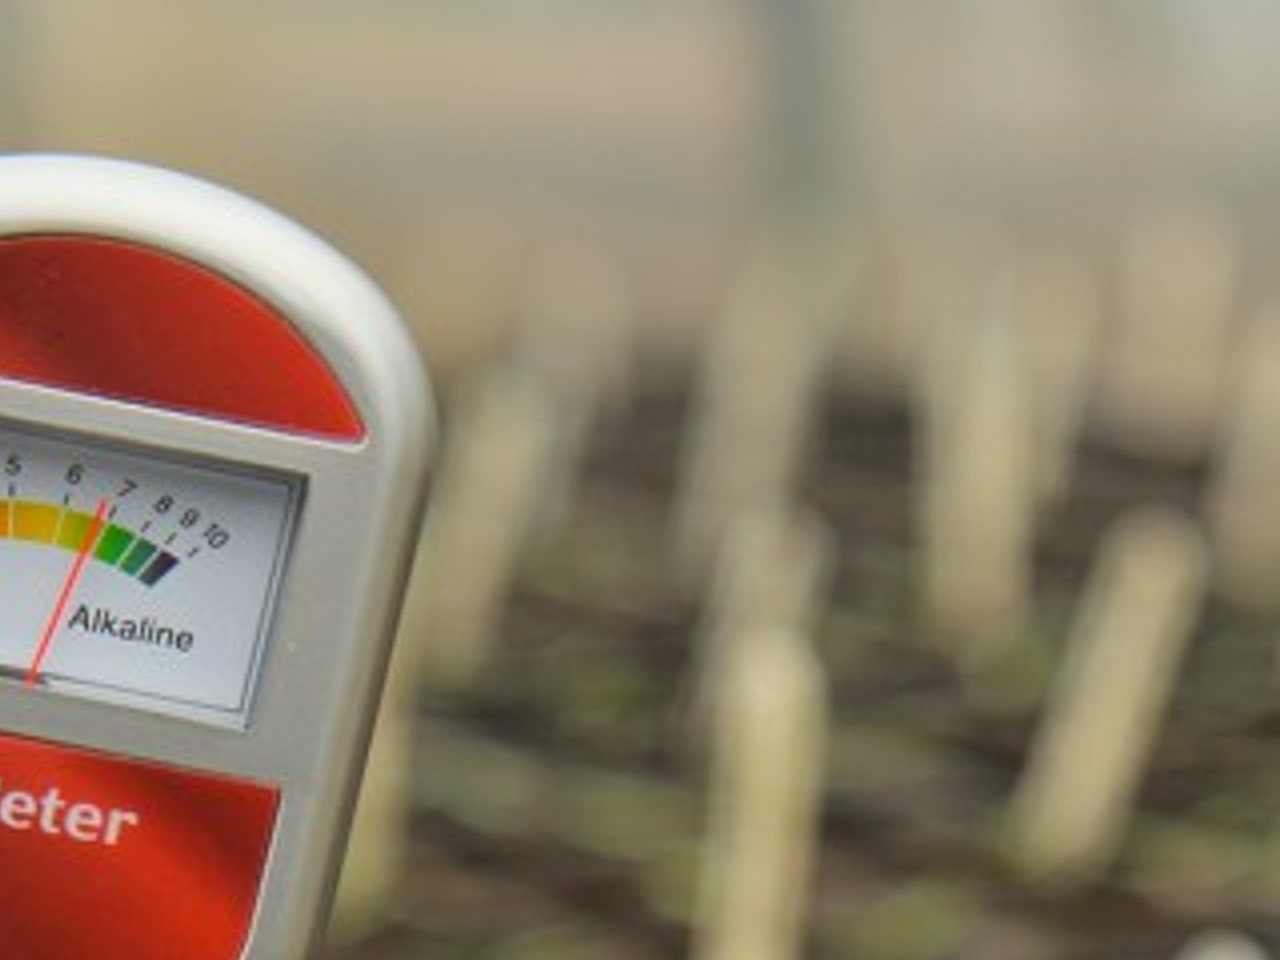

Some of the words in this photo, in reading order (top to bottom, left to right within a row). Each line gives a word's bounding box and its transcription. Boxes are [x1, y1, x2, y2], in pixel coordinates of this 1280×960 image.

[3, 456, 22, 477] 5
[64, 463, 84, 486] 6
[116, 478, 139, 499] 7
[152, 493, 173, 516] 8
[178, 506, 201, 530] 9
[202, 520, 231, 551] 10
[66, 603, 196, 653] Alkaline
